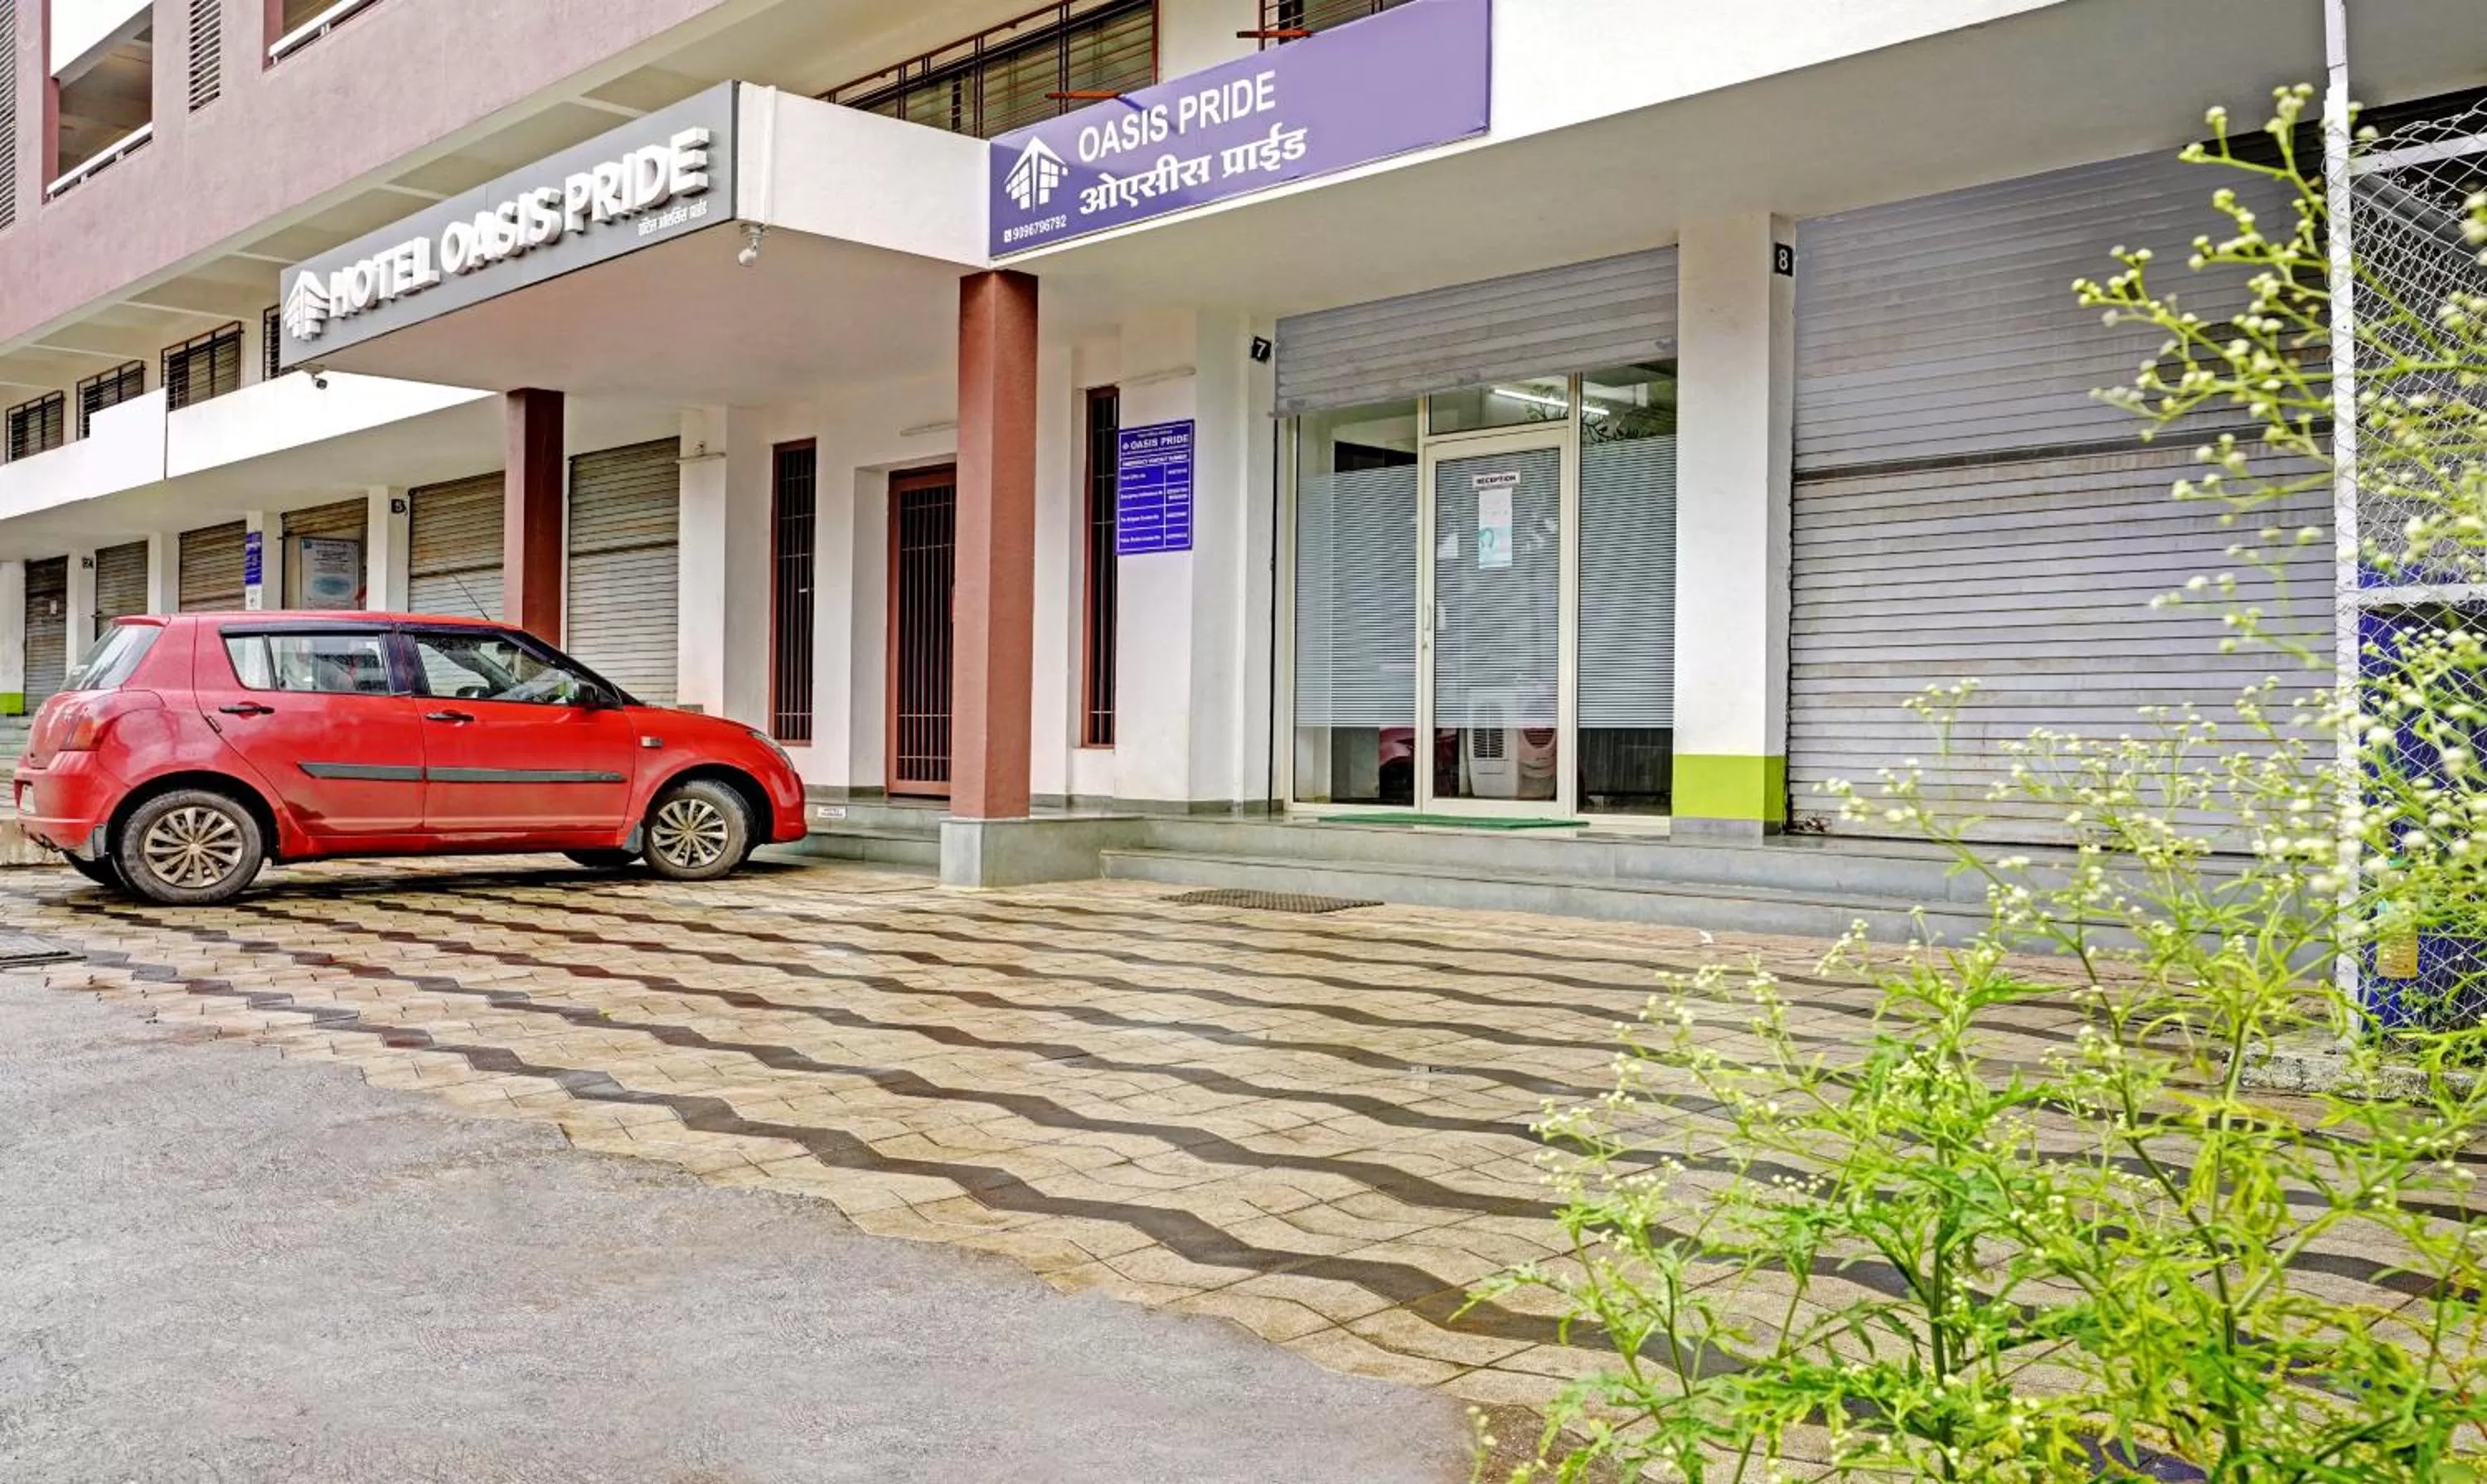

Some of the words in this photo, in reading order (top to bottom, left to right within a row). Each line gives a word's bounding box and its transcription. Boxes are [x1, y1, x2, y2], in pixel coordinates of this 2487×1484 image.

[1079, 109, 1168, 163] OASIS
[1179, 70, 1276, 134] PRIDE
[1079, 155, 1210, 216] ओएसीस
[1221, 123, 1307, 178] प्राईड
[329, 236, 440, 318] HOTEL
[440, 187, 563, 274] OASIS
[565, 127, 710, 232] PRIDE
[1778, 249, 1788, 270] 8
[1256, 340, 1267, 357] 7
[1130, 438, 1158, 450] OASIS
[1161, 434, 1189, 446] PRIDE
[1476, 474, 1516, 485] RECEPTION
